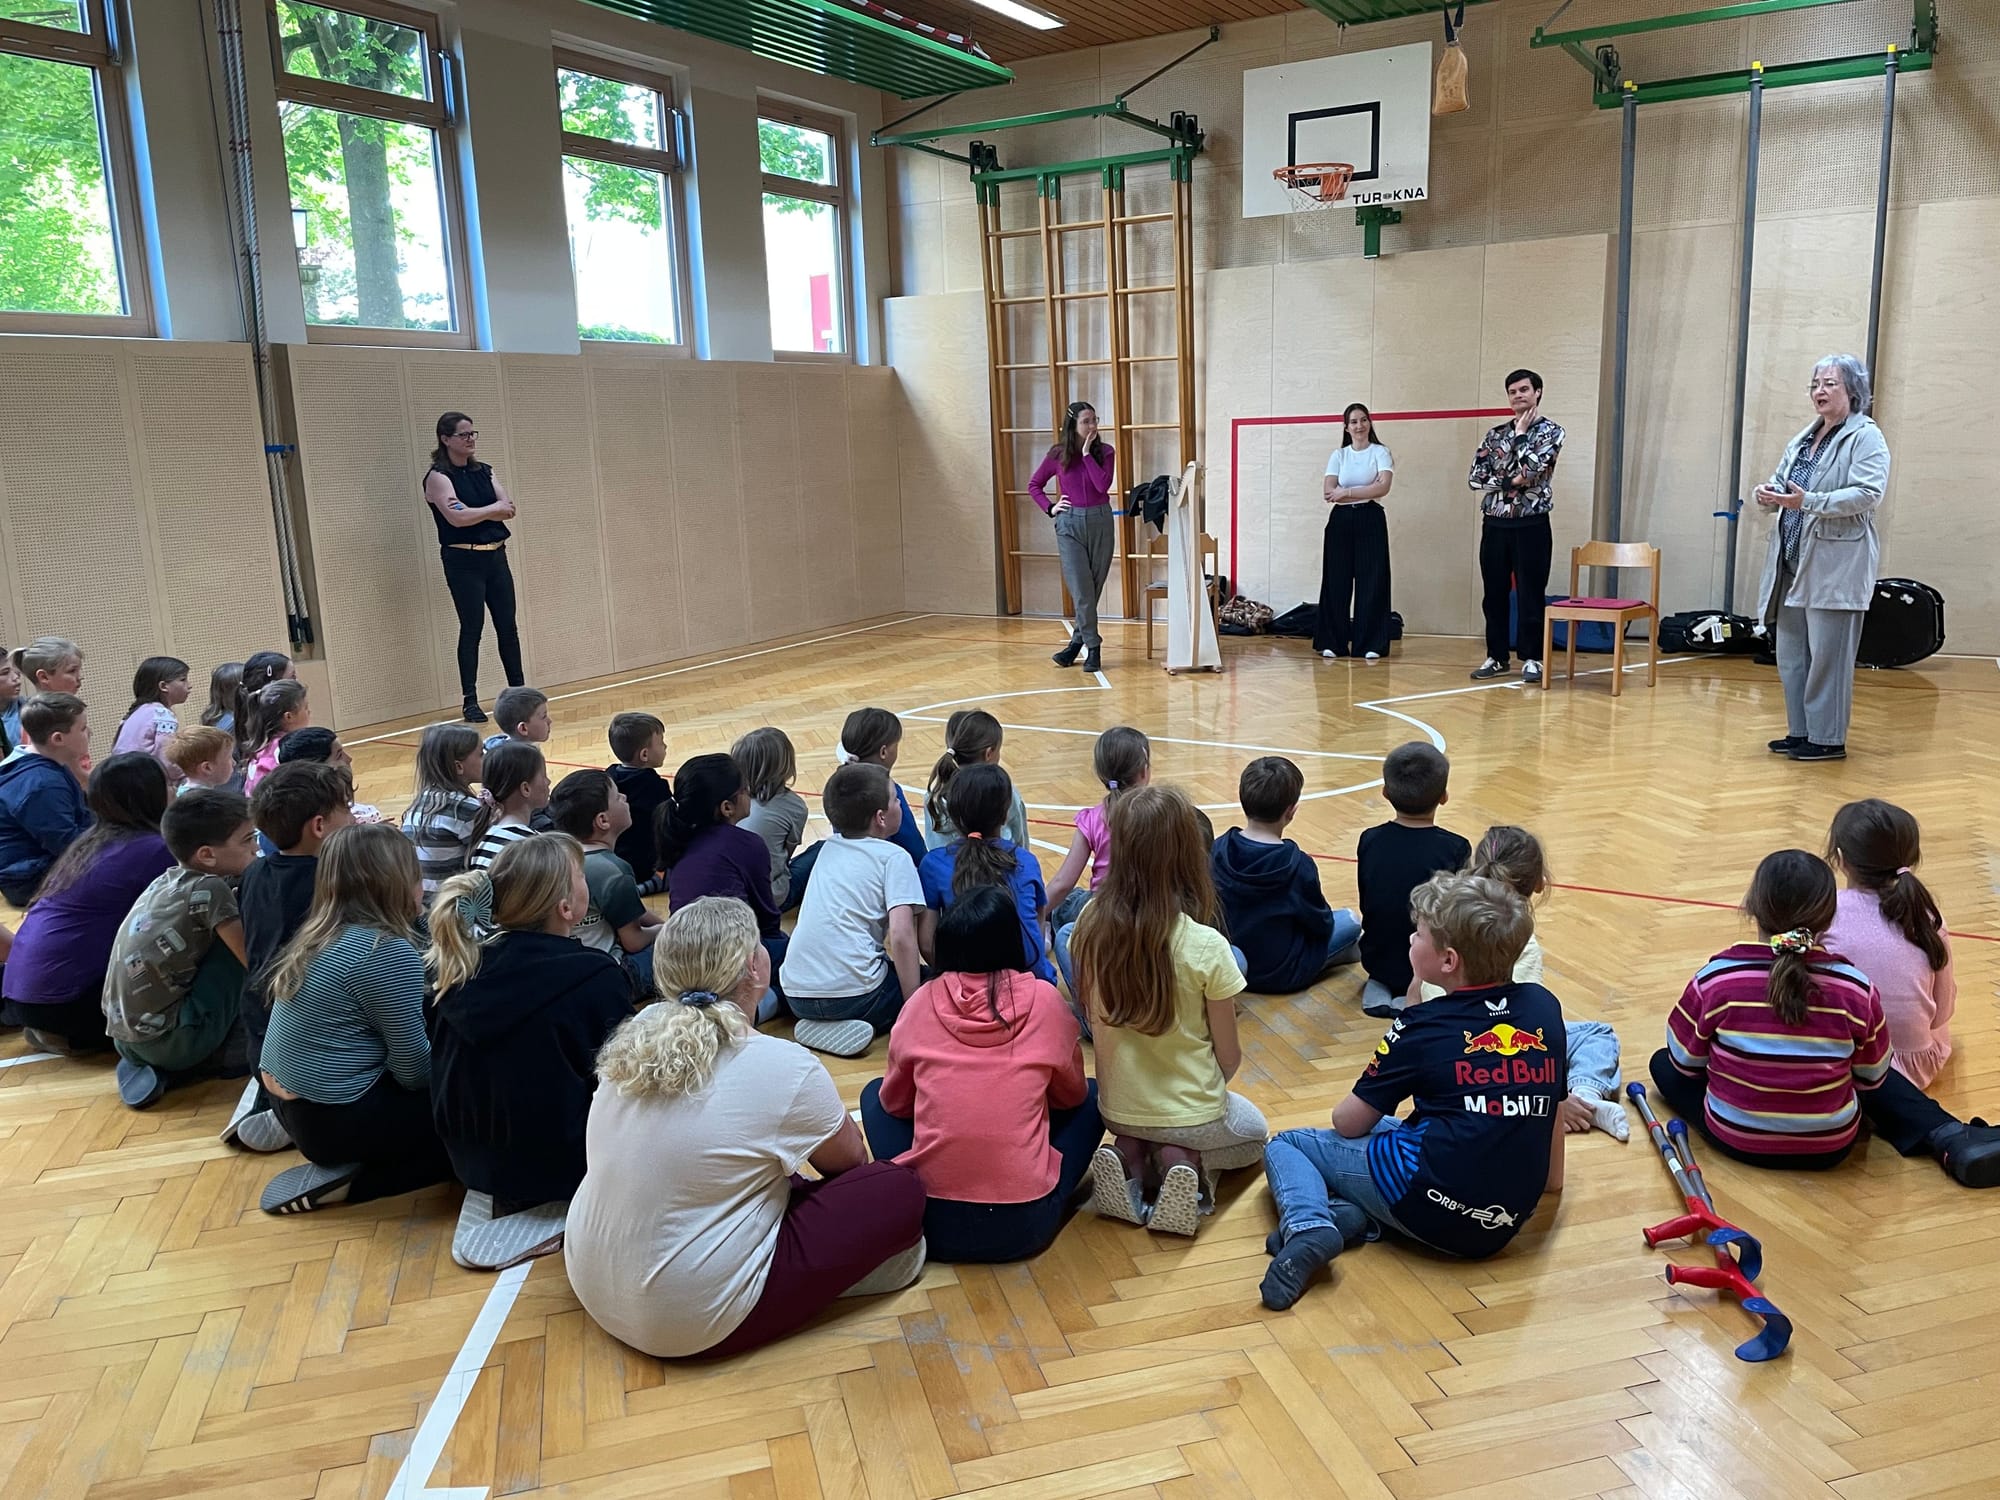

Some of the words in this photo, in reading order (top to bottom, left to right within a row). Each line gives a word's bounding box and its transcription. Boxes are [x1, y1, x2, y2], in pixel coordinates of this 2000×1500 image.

[1352, 192, 1382, 205] TUR
[1393, 187, 1425, 201] KNA
[1455, 1058, 1510, 1086] Red
[1512, 1057, 1556, 1084] Bull
[1463, 1095, 1531, 1117] Mobil
